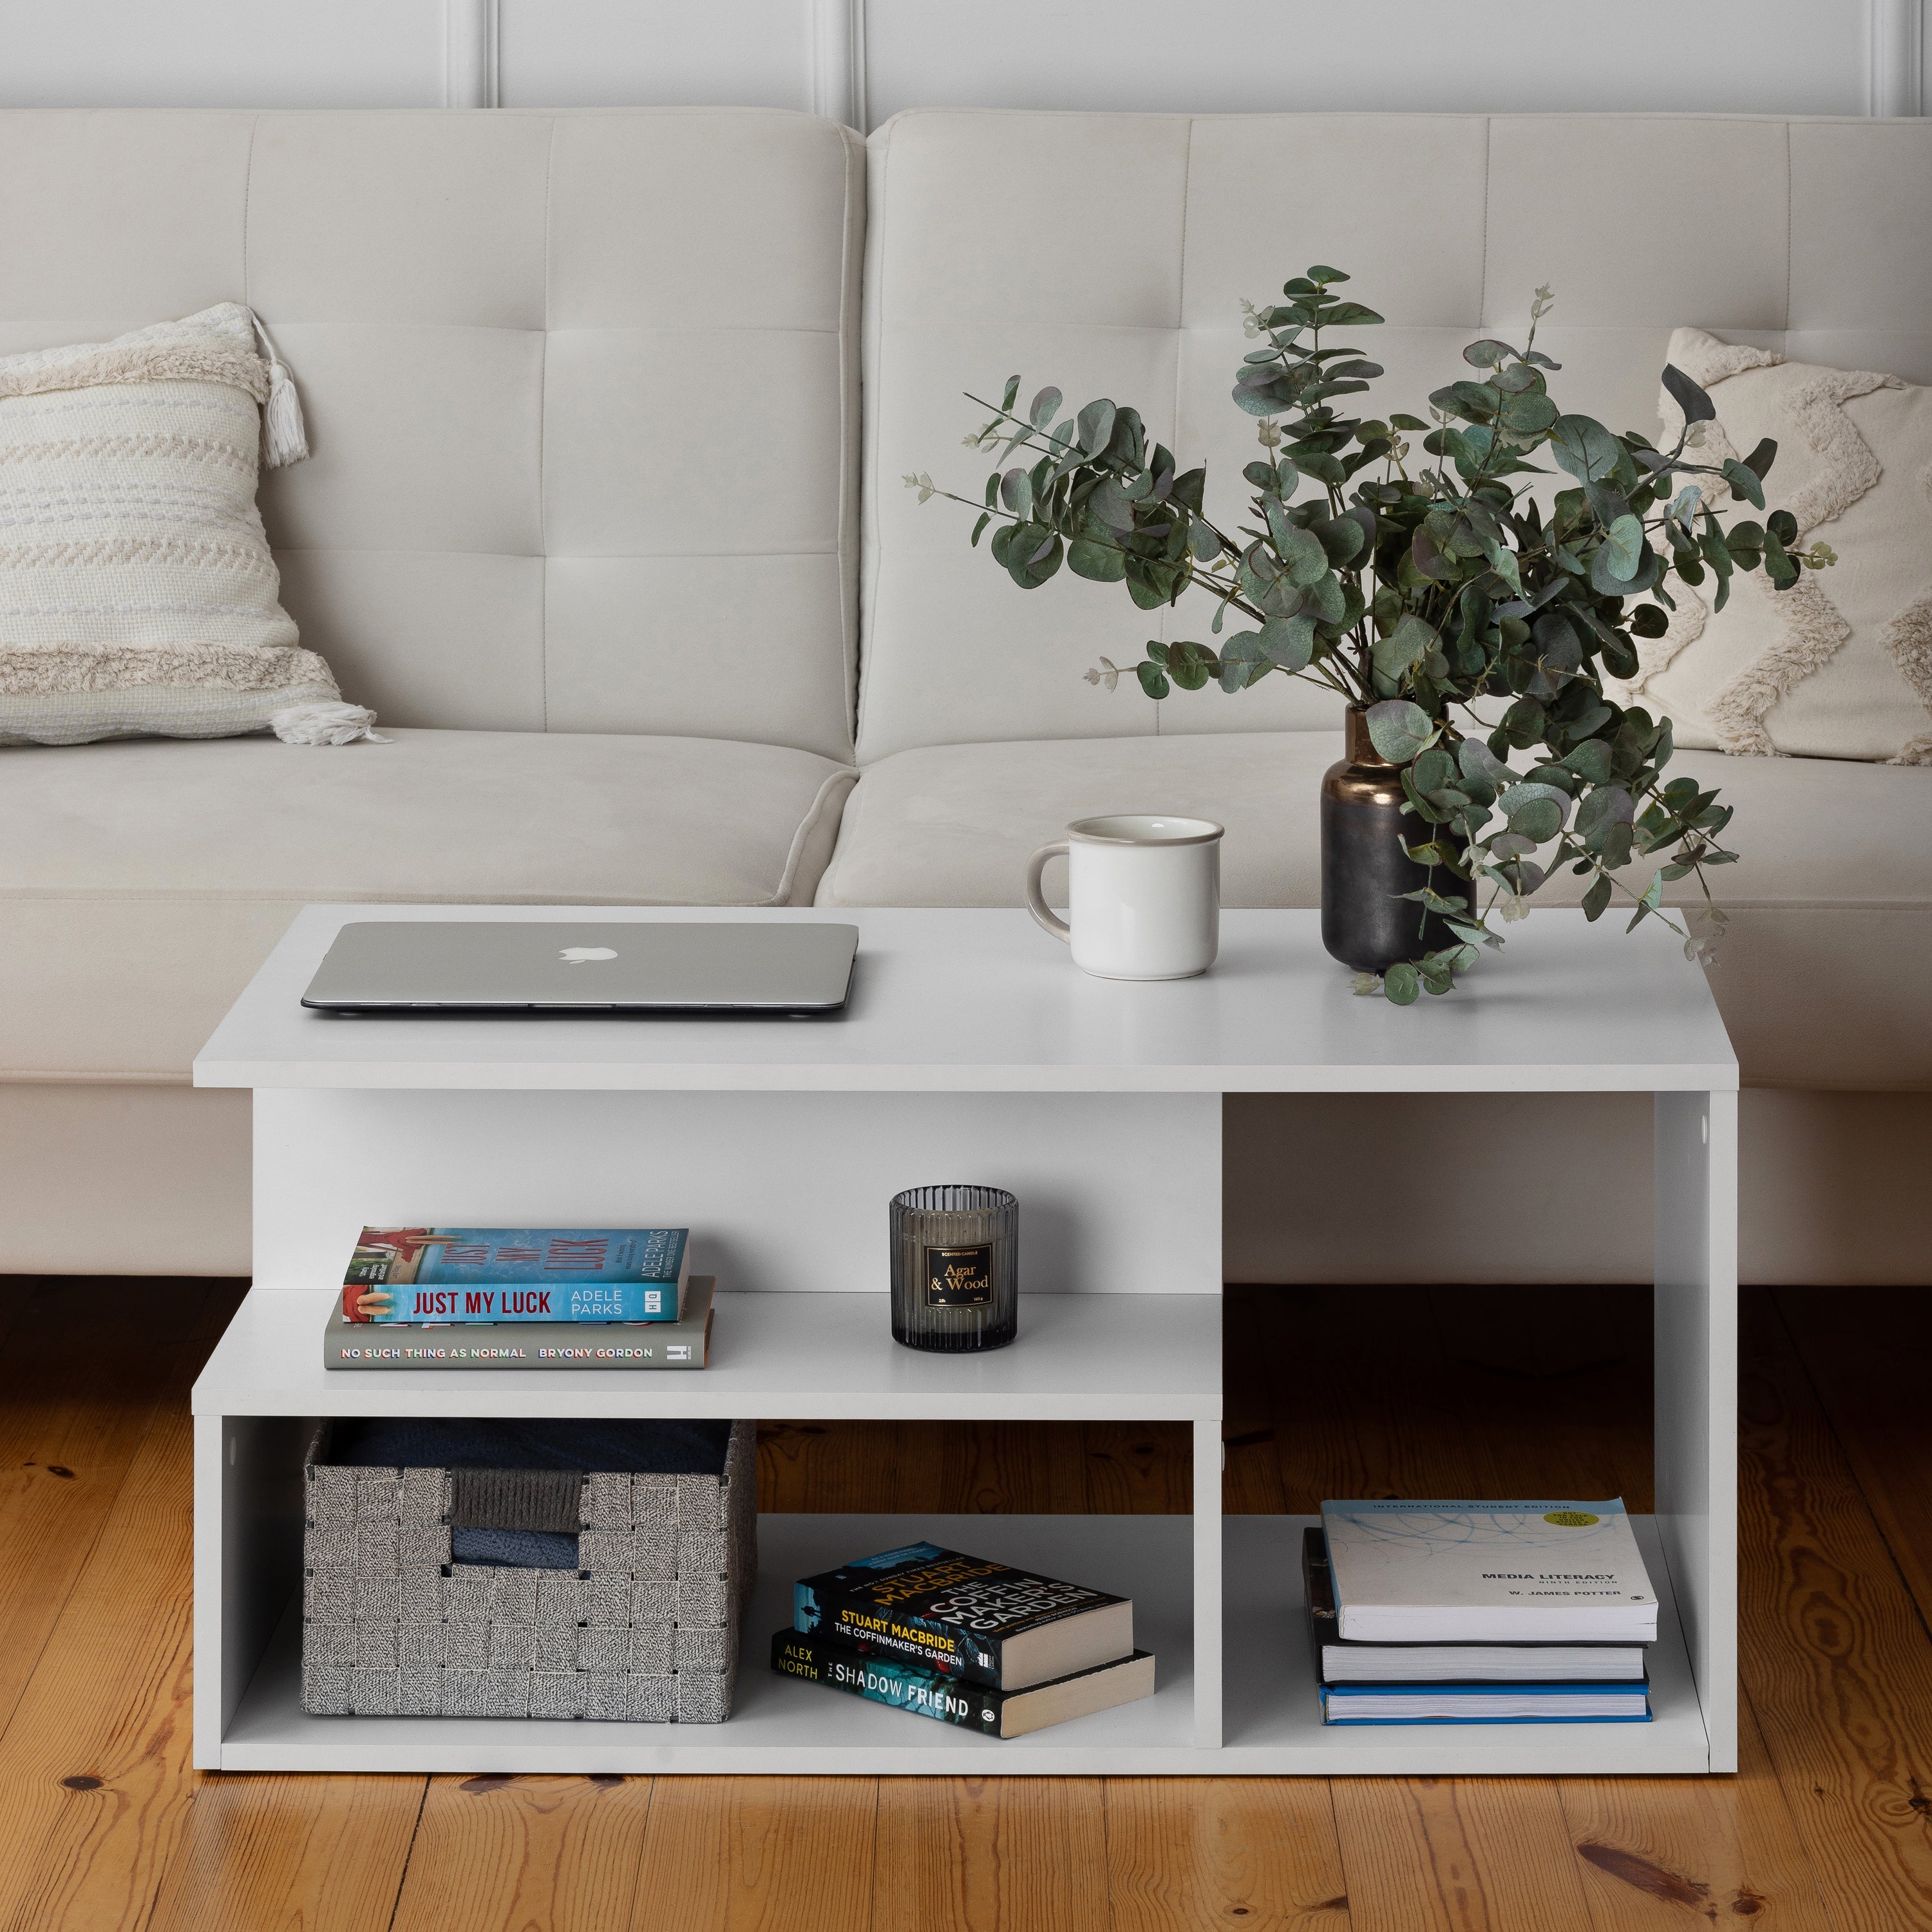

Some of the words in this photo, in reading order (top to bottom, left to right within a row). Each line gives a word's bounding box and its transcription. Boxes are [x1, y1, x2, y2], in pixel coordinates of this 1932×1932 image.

[645, 1231, 668, 1252] PARKS
[668, 1231, 679, 1249] BESTSELLER
[441, 1243, 489, 1265] JUST
[495, 1247, 542, 1261] MY
[544, 1238, 609, 1269] LUCK
[665, 1256, 674, 1271] NUMBER
[641, 1253, 664, 1278] ADELE
[944, 1264, 976, 1279] Agar
[931, 1278, 943, 1291] &
[945, 1275, 989, 1291] Wood
[413, 1292, 459, 1314] JUST
[466, 1292, 495, 1314] MY
[502, 1291, 551, 1314] LUCK
[571, 1290, 623, 1301] ADELE
[572, 1303, 623, 1314] PARKS
[341, 1349, 361, 1358] NO
[364, 1349, 400, 1358] SUCH
[404, 1349, 446, 1358] THING
[449, 1349, 467, 1358] AS
[470, 1349, 526, 1358] NORMAL
[538, 1349, 593, 1358] BRYONY
[596, 1349, 652, 1358] GORDON
[872, 1562, 971, 1593] STUART
[880, 1572, 904, 1582] SUNDAY
[927, 1557, 965, 1568] BESTSELLER
[873, 1563, 1010, 1605] MACBRIDE
[930, 1578, 1044, 1613] COFFIN
[940, 1581, 989, 1595] THE
[940, 1583, 1075, 1625] MAKER'S
[970, 1589, 1098, 1629] GARDEN
[841, 1610, 888, 1633] STUART
[891, 1624, 955, 1653] MACBRIDE
[784, 1644, 812, 1662] ALEX
[835, 1622, 851, 1634] THE
[853, 1627, 923, 1656] COFFINMAKER'S
[925, 1648, 962, 1667] GARDEN
[778, 1658, 818, 1680] NORTH
[836, 1663, 902, 1698] SHADOW
[907, 1685, 969, 1717] FRIEND
